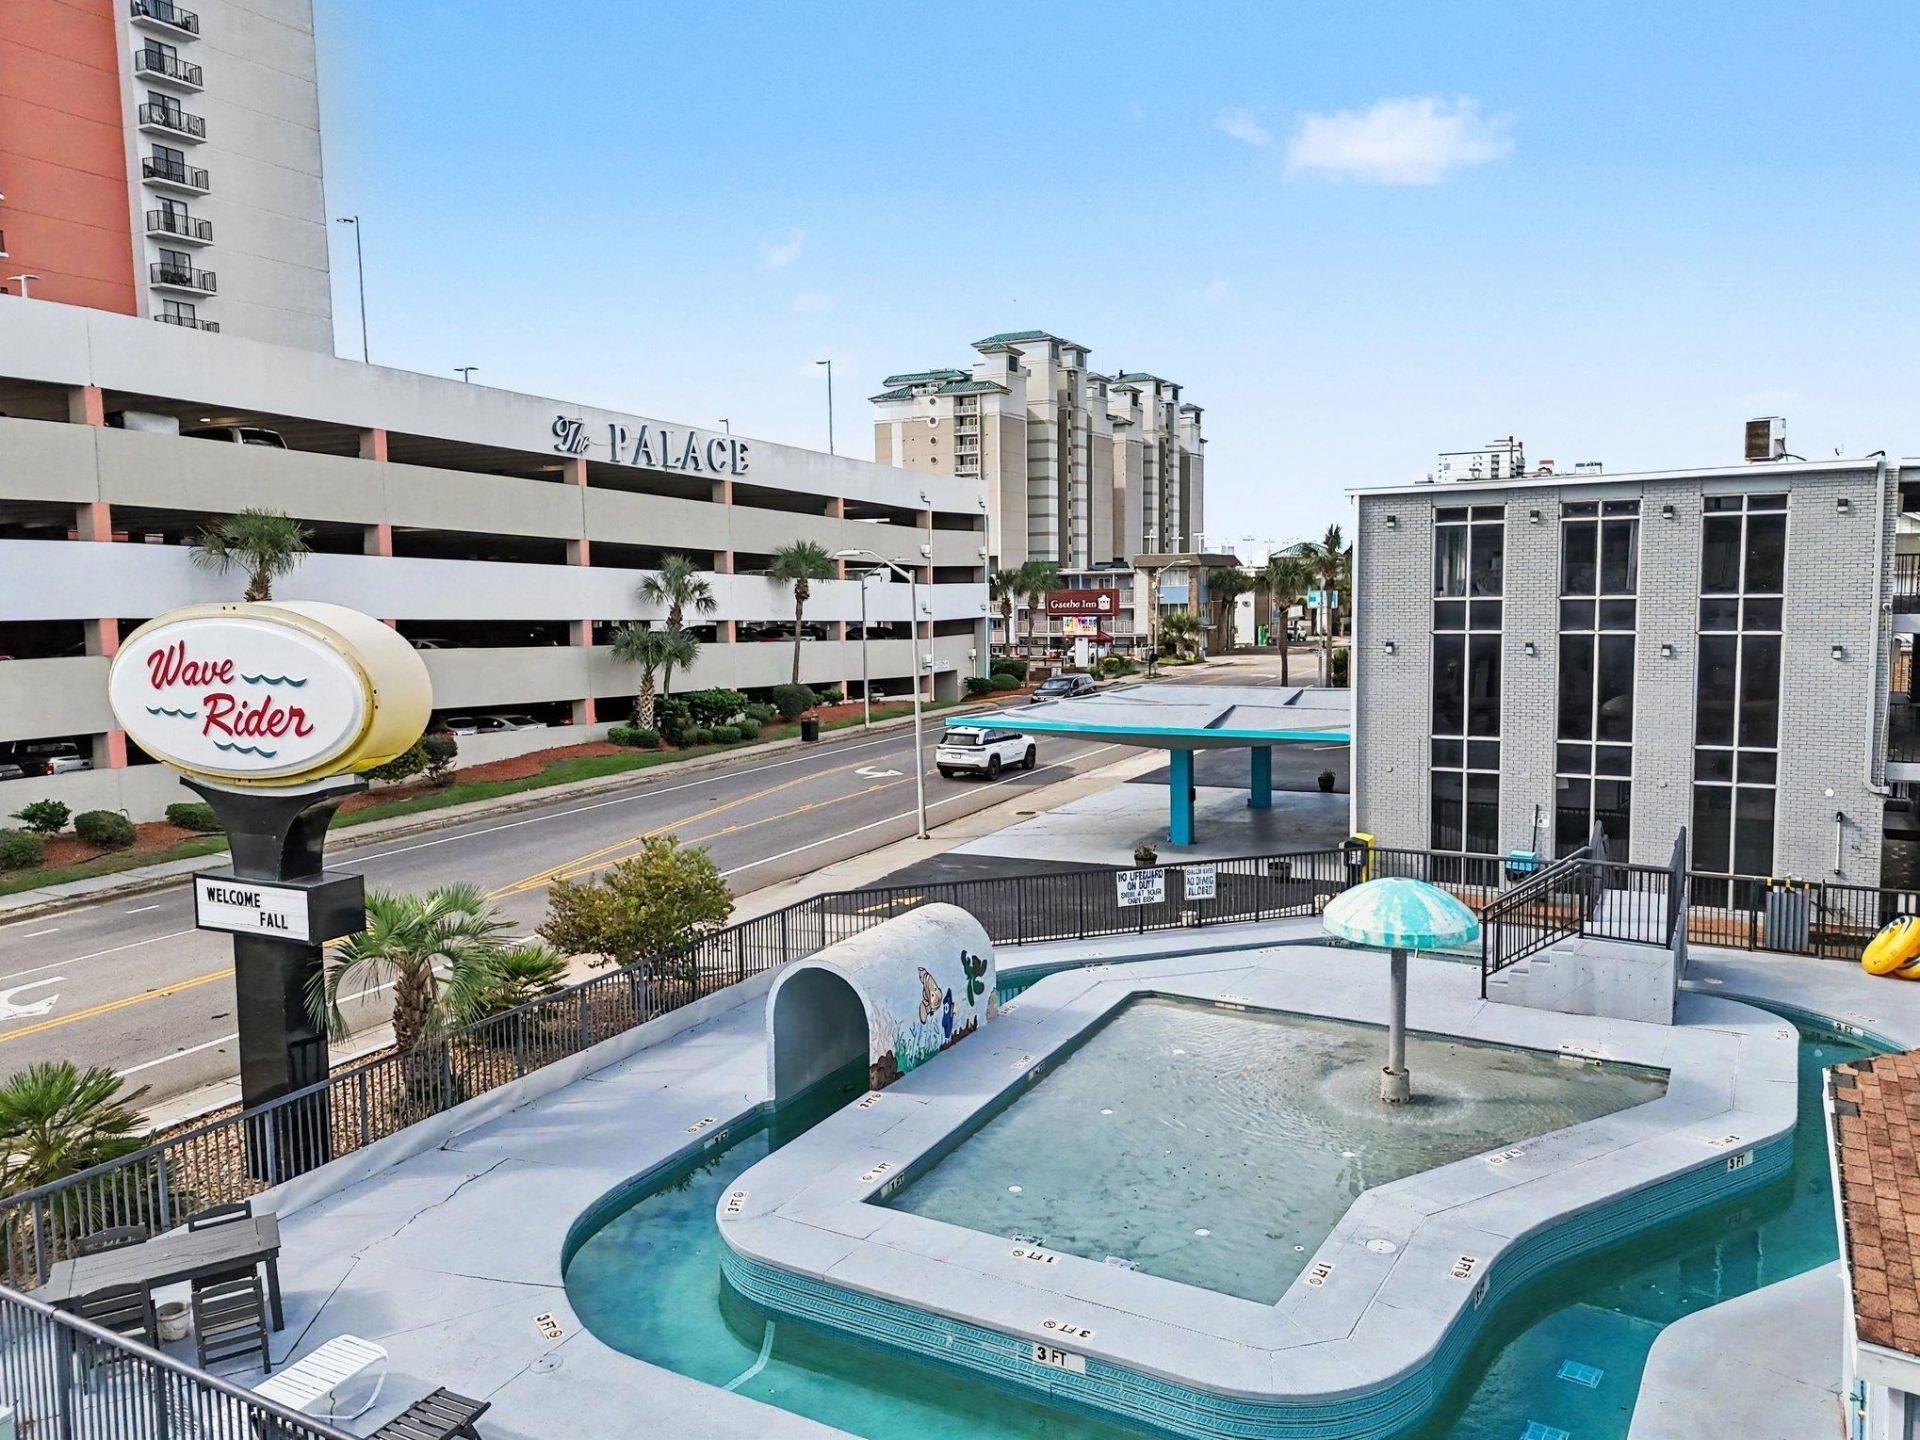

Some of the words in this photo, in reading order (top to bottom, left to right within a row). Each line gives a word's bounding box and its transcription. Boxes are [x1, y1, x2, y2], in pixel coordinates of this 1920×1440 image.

[552, 415, 591, 454] The
[608, 424, 750, 475] PALACE
[1081, 599, 1097, 608] Inn
[147, 639, 234, 689] Wave
[202, 692, 314, 737] Rider
[206, 887, 261, 908] WELCOME
[259, 912, 289, 930] FALL
[536, 1314, 550, 1322] 3
[540, 1320, 557, 1331] FT
[1058, 1324, 1077, 1334] FT
[1079, 1330, 1091, 1338] 3
[1037, 1346, 1047, 1361] 3
[1051, 1349, 1067, 1366] FT
